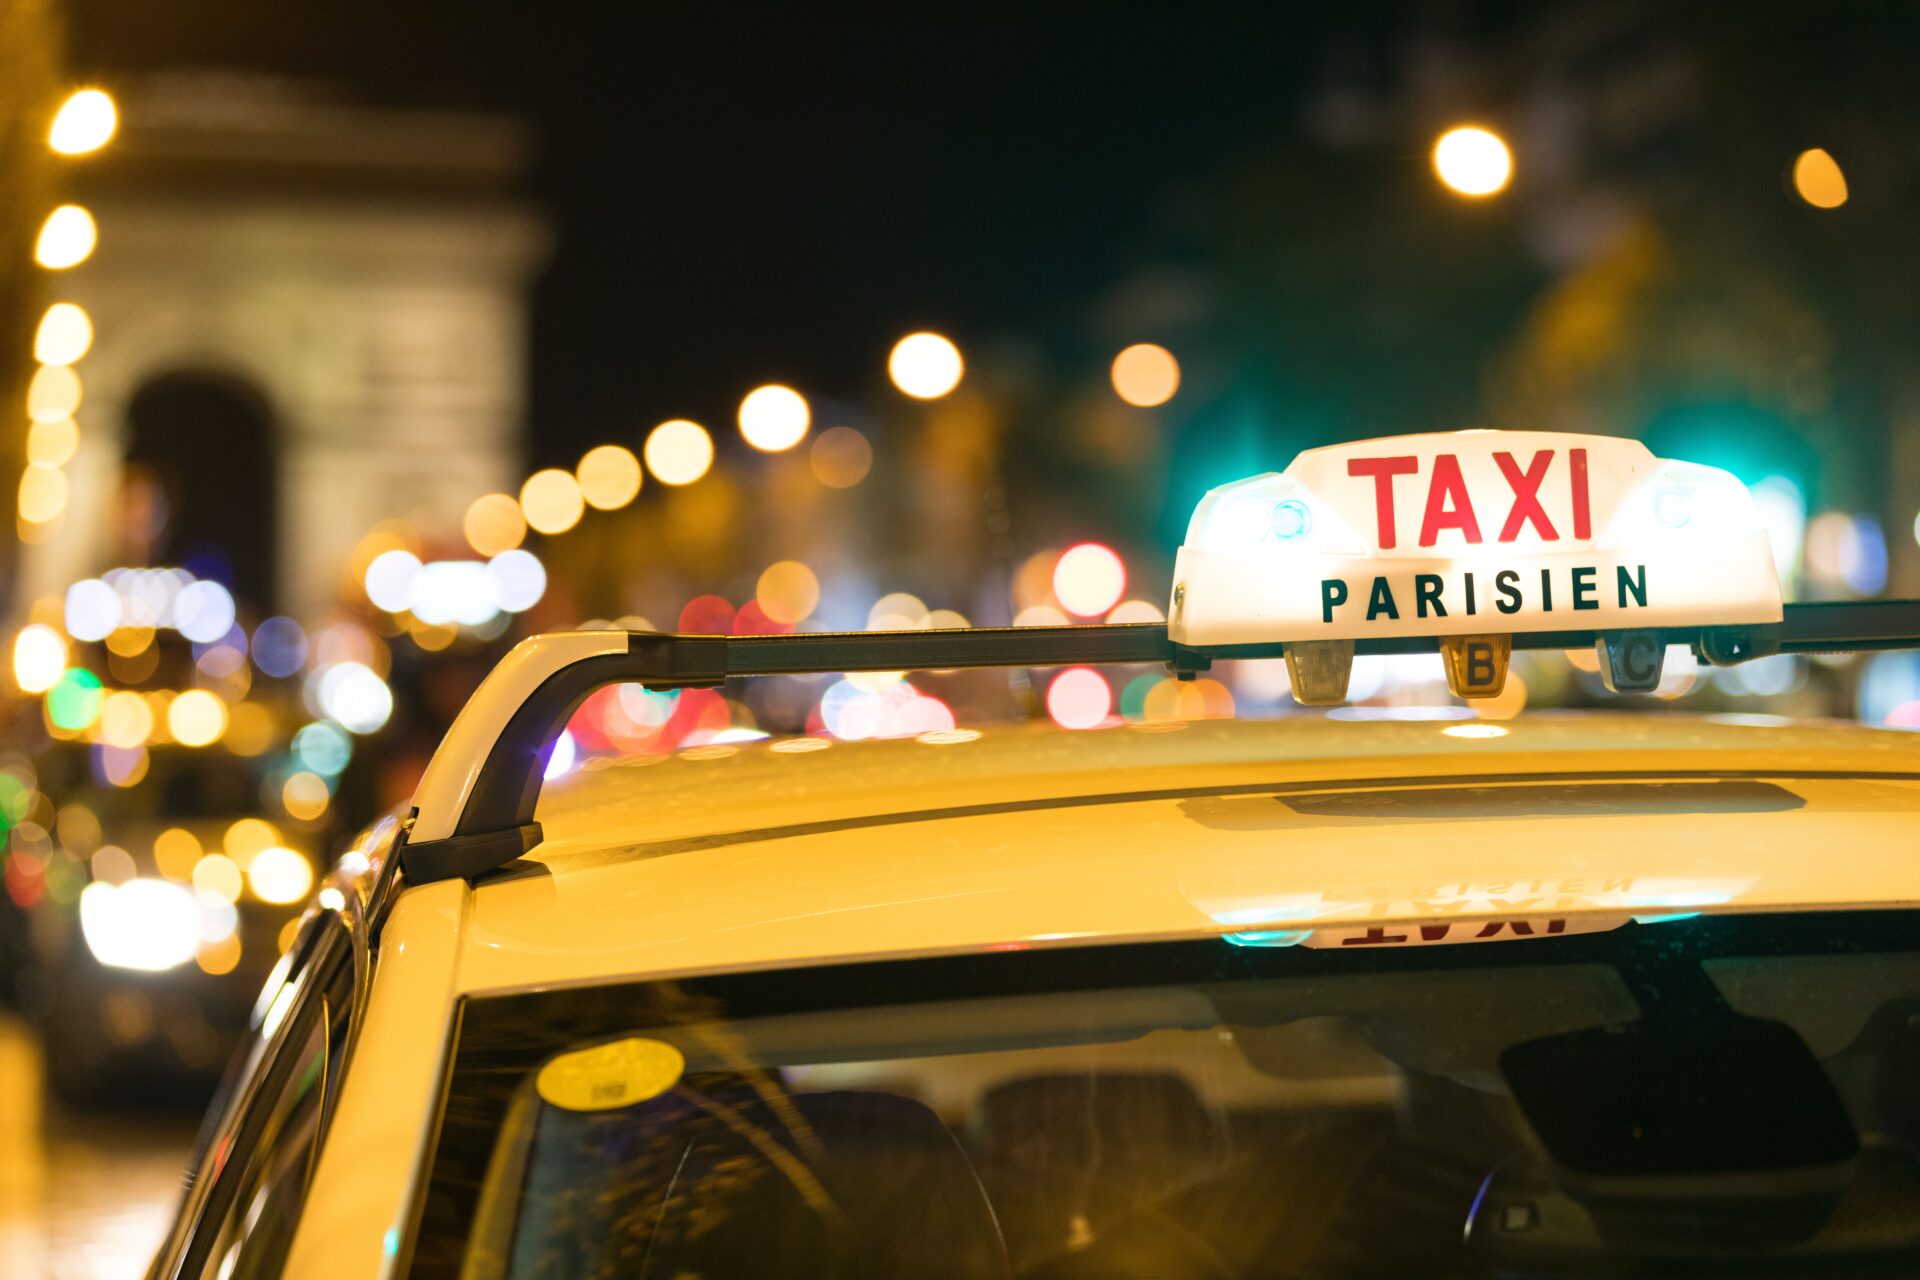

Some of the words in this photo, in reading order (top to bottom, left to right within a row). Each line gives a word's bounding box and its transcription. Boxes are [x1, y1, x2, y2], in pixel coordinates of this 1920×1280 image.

[1347, 448, 1592, 549] TAXI
[1321, 564, 1649, 623] PARISIEN
[1467, 643, 1496, 687] B
[1623, 637, 1655, 682] C
